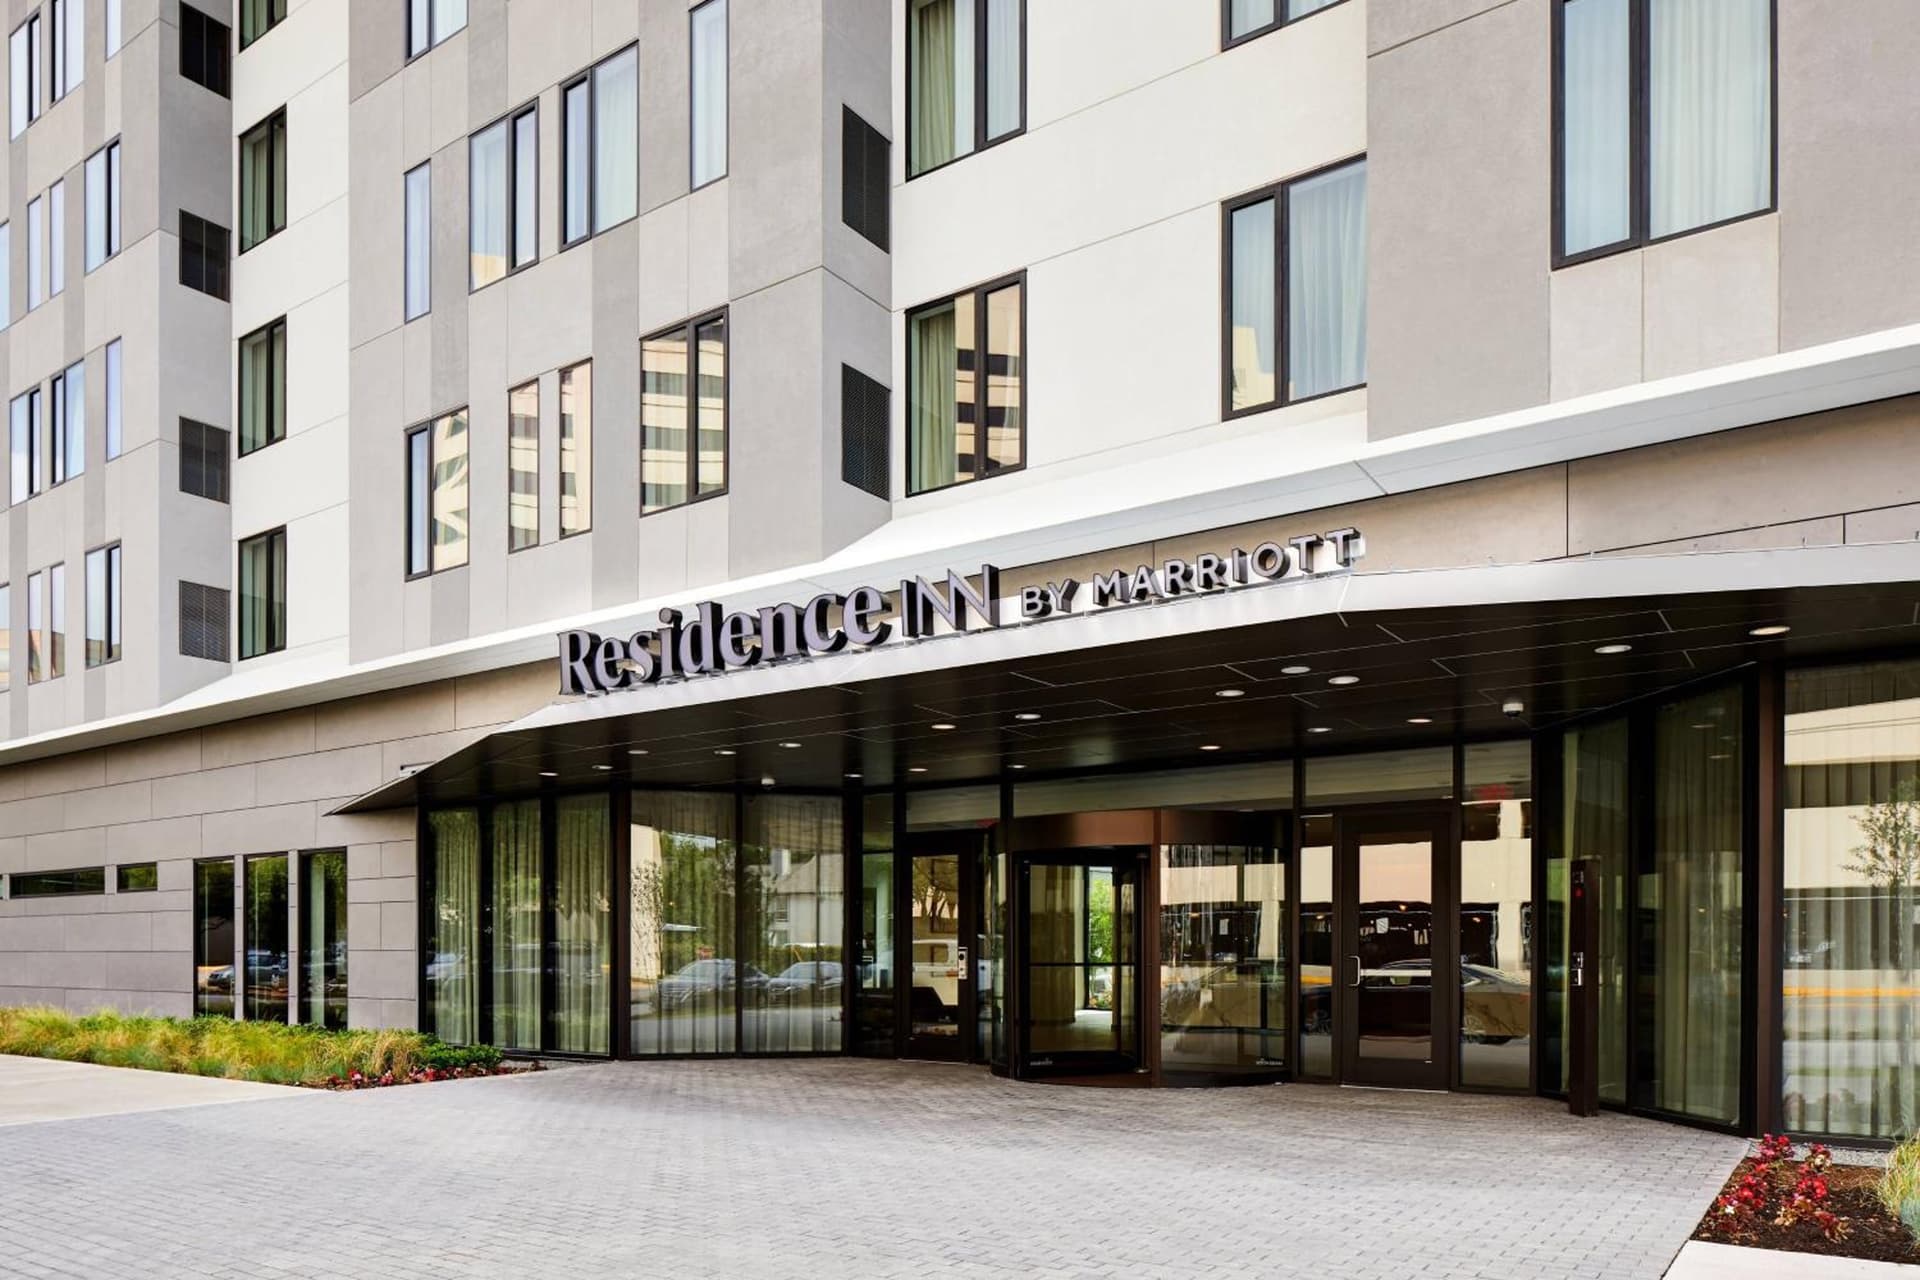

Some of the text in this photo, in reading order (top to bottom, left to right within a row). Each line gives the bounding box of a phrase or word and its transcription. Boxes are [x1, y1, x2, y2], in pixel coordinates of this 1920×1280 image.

[558, 527, 1360, 695] Residence INN BY MARRIOTT
